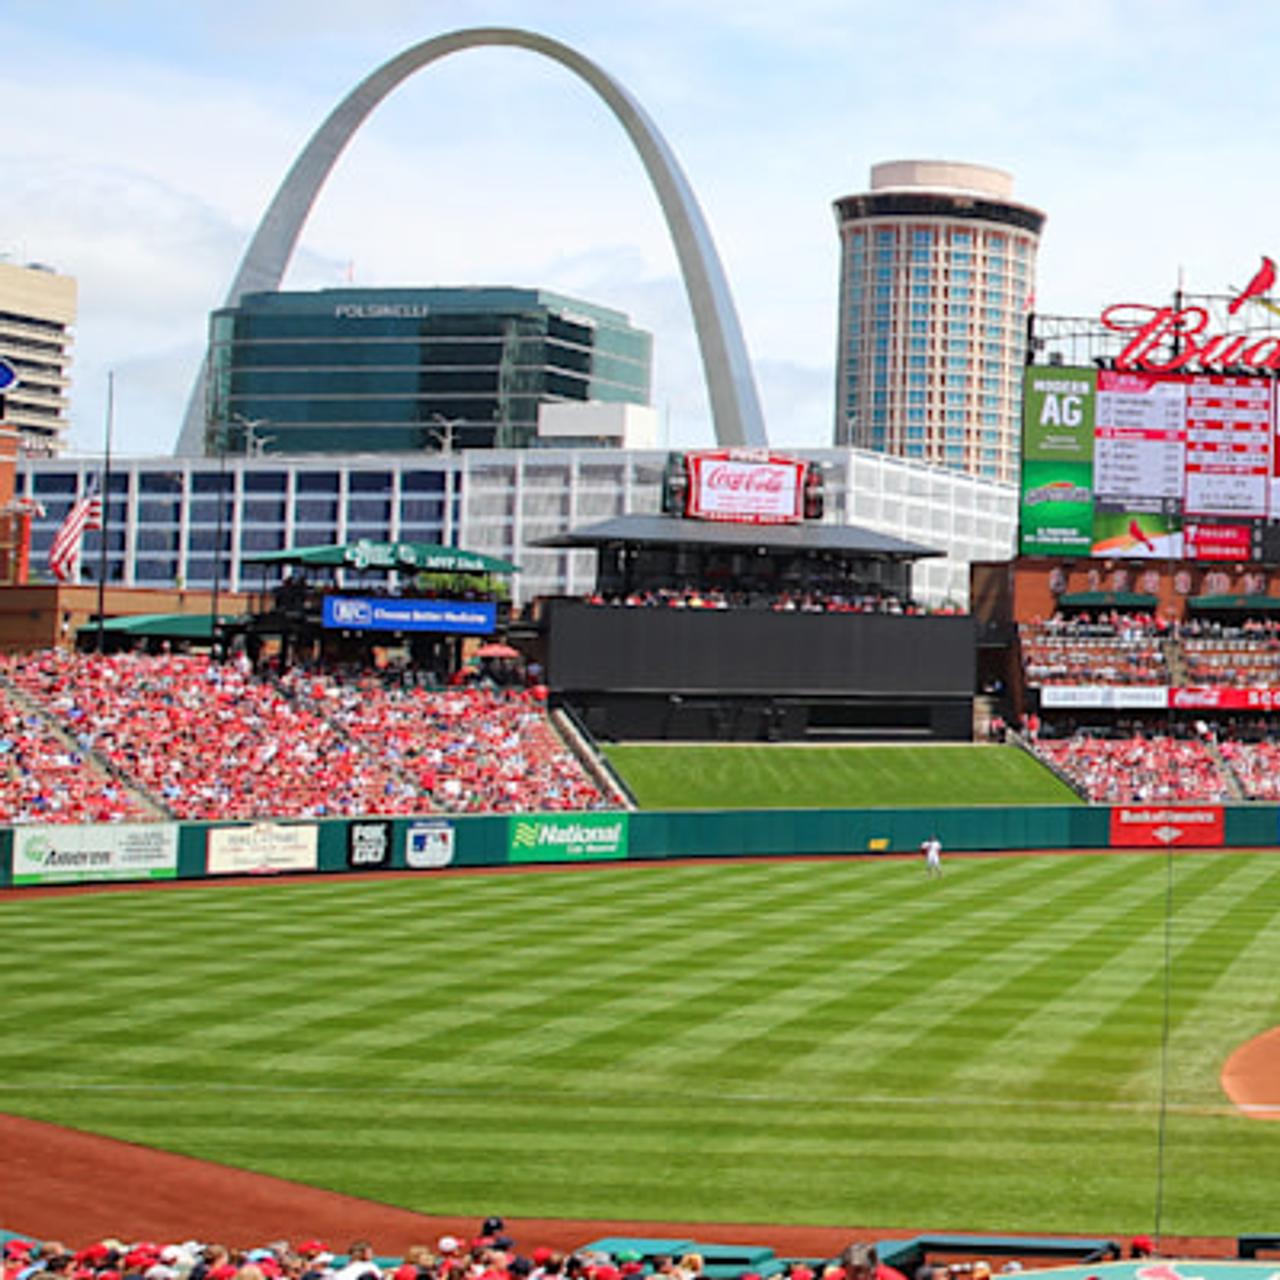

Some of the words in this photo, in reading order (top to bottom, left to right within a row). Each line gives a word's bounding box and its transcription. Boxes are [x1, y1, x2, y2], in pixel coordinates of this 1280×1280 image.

[336, 304, 428, 318] POLSINELLI
[1040, 397, 1082, 426] AG
[708, 465, 786, 493] Coca-Cola
[538, 823, 622, 844] National
[43, 850, 110, 867] Ameren
